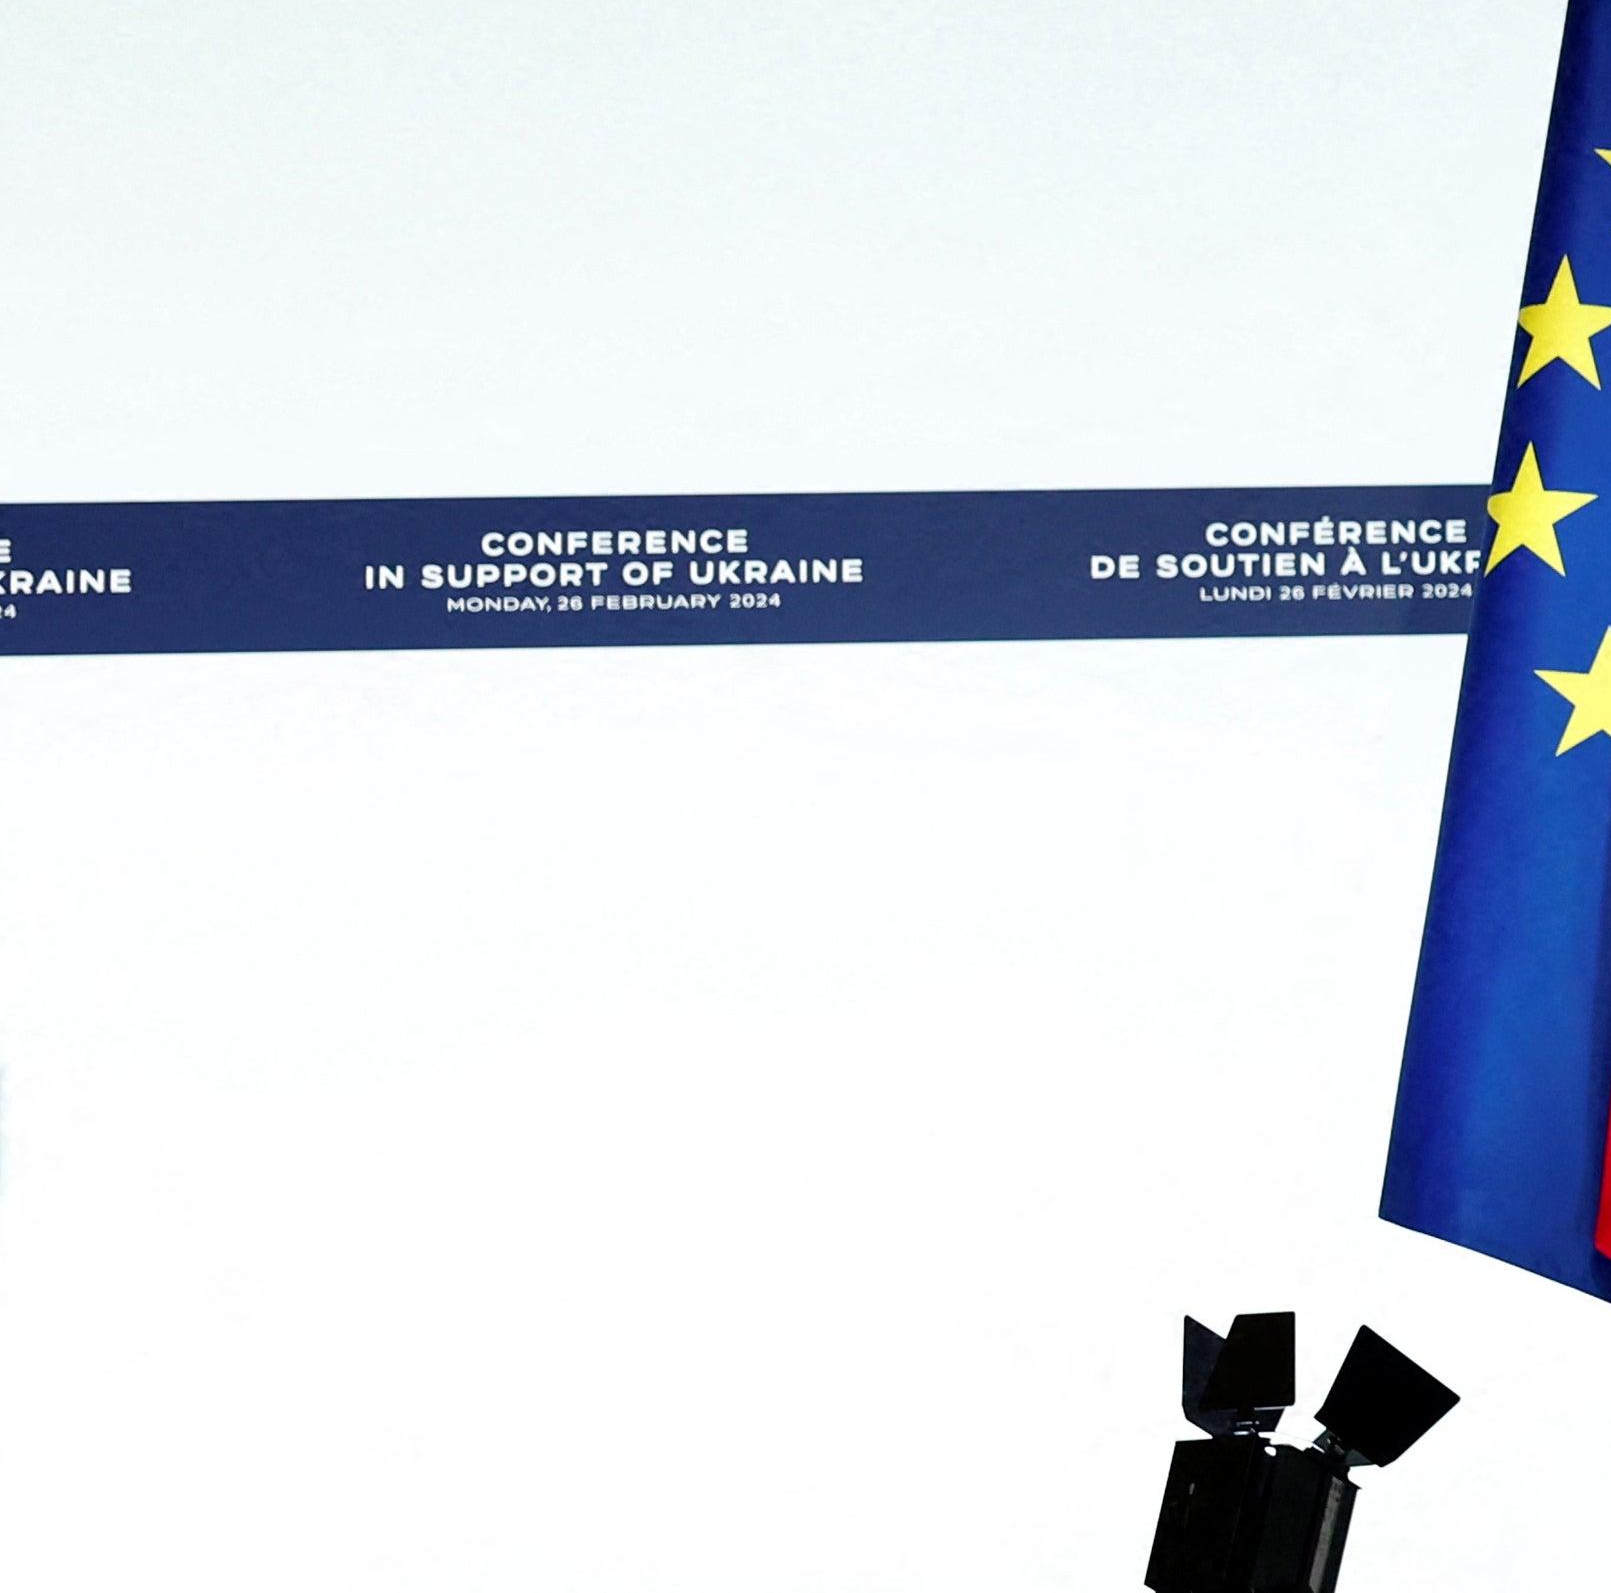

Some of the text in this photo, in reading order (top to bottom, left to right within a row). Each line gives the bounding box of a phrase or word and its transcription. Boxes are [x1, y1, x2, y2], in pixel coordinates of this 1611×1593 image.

[481, 528, 749, 557] CONFERENCE
[1205, 516, 1468, 548] CONFÉRENCE
[365, 558, 864, 590] IN SUPPORT OF UKRAINE
[1090, 554, 1141, 580] DE
[1155, 552, 1326, 579] SOUTIEN
[1340, 546, 1368, 576] À
[0, 568, 132, 595] RAINE
[1199, 582, 1473, 602] LUNDI 26 FÉVRIER 2024
[447, 592, 782, 614] MONDAY, 26 FEBRUARY 2024
